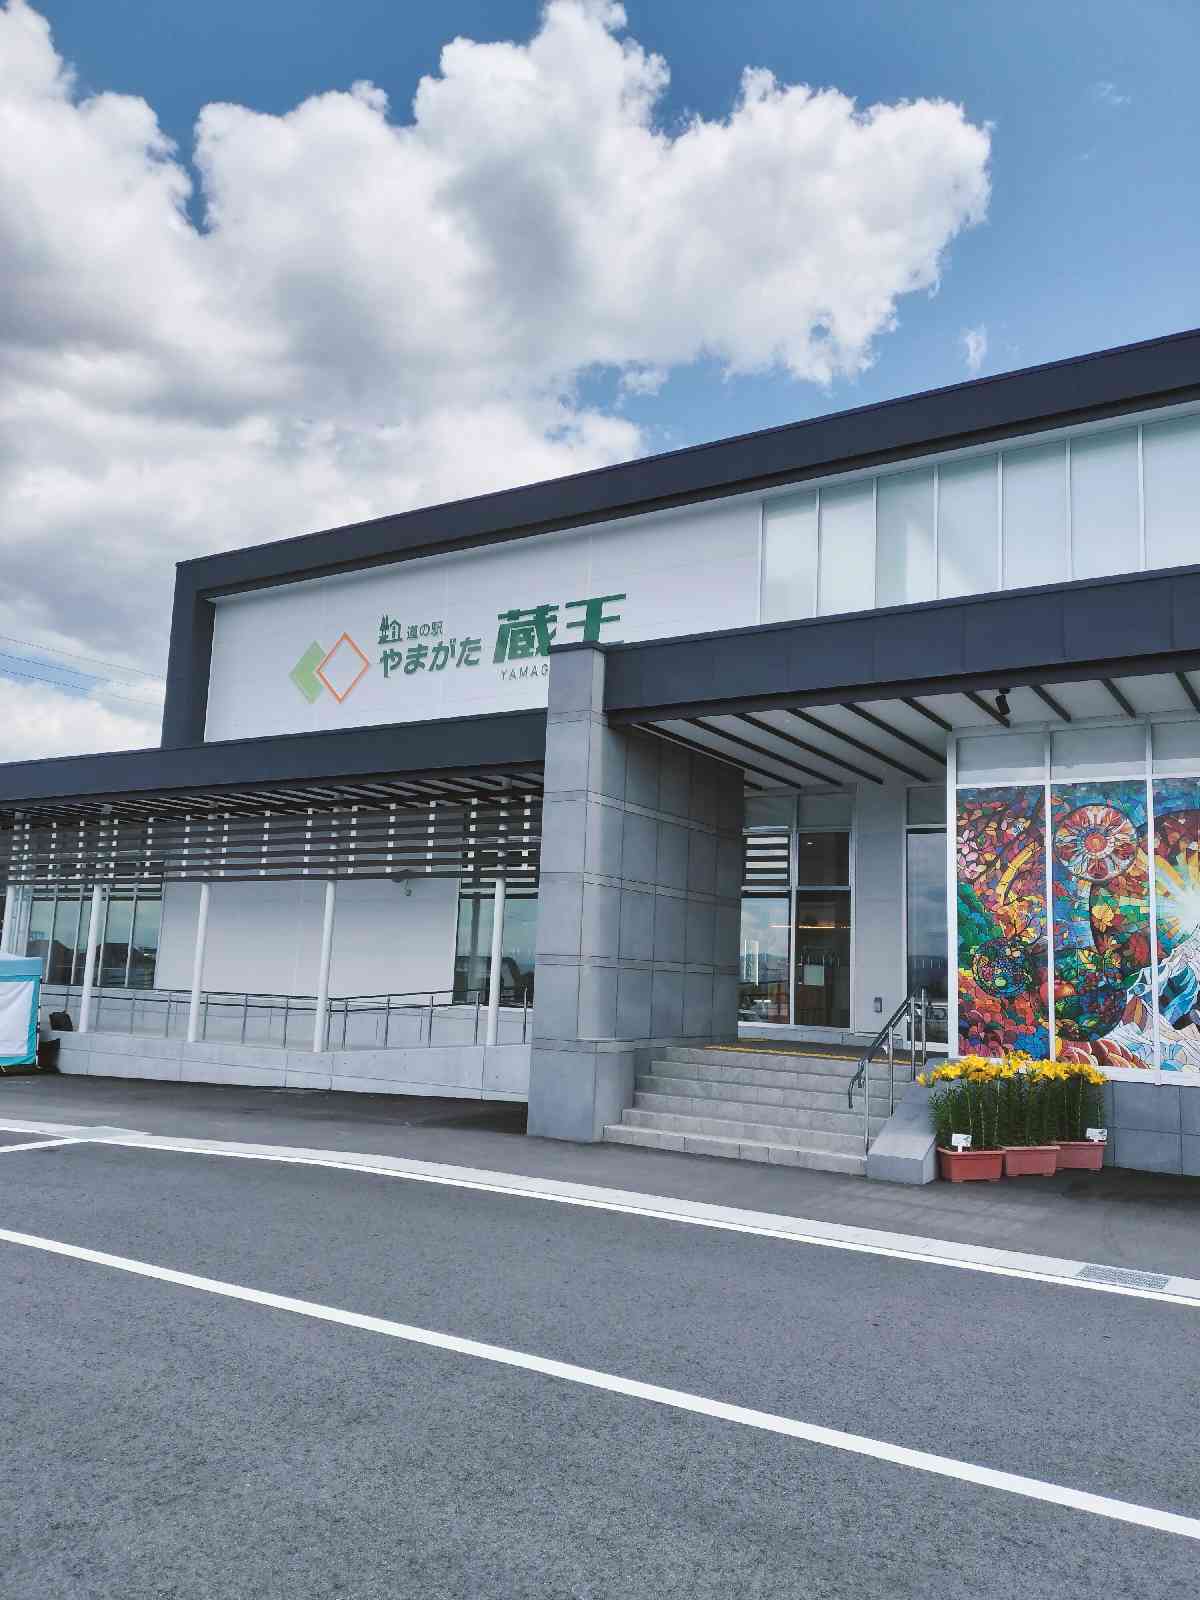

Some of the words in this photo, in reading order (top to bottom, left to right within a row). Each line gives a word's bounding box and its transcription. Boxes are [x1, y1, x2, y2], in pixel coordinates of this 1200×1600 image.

[379, 637, 482, 678] やまがた
[492, 593, 627, 664] 蔵王
[407, 620, 444, 639] 道の駅
